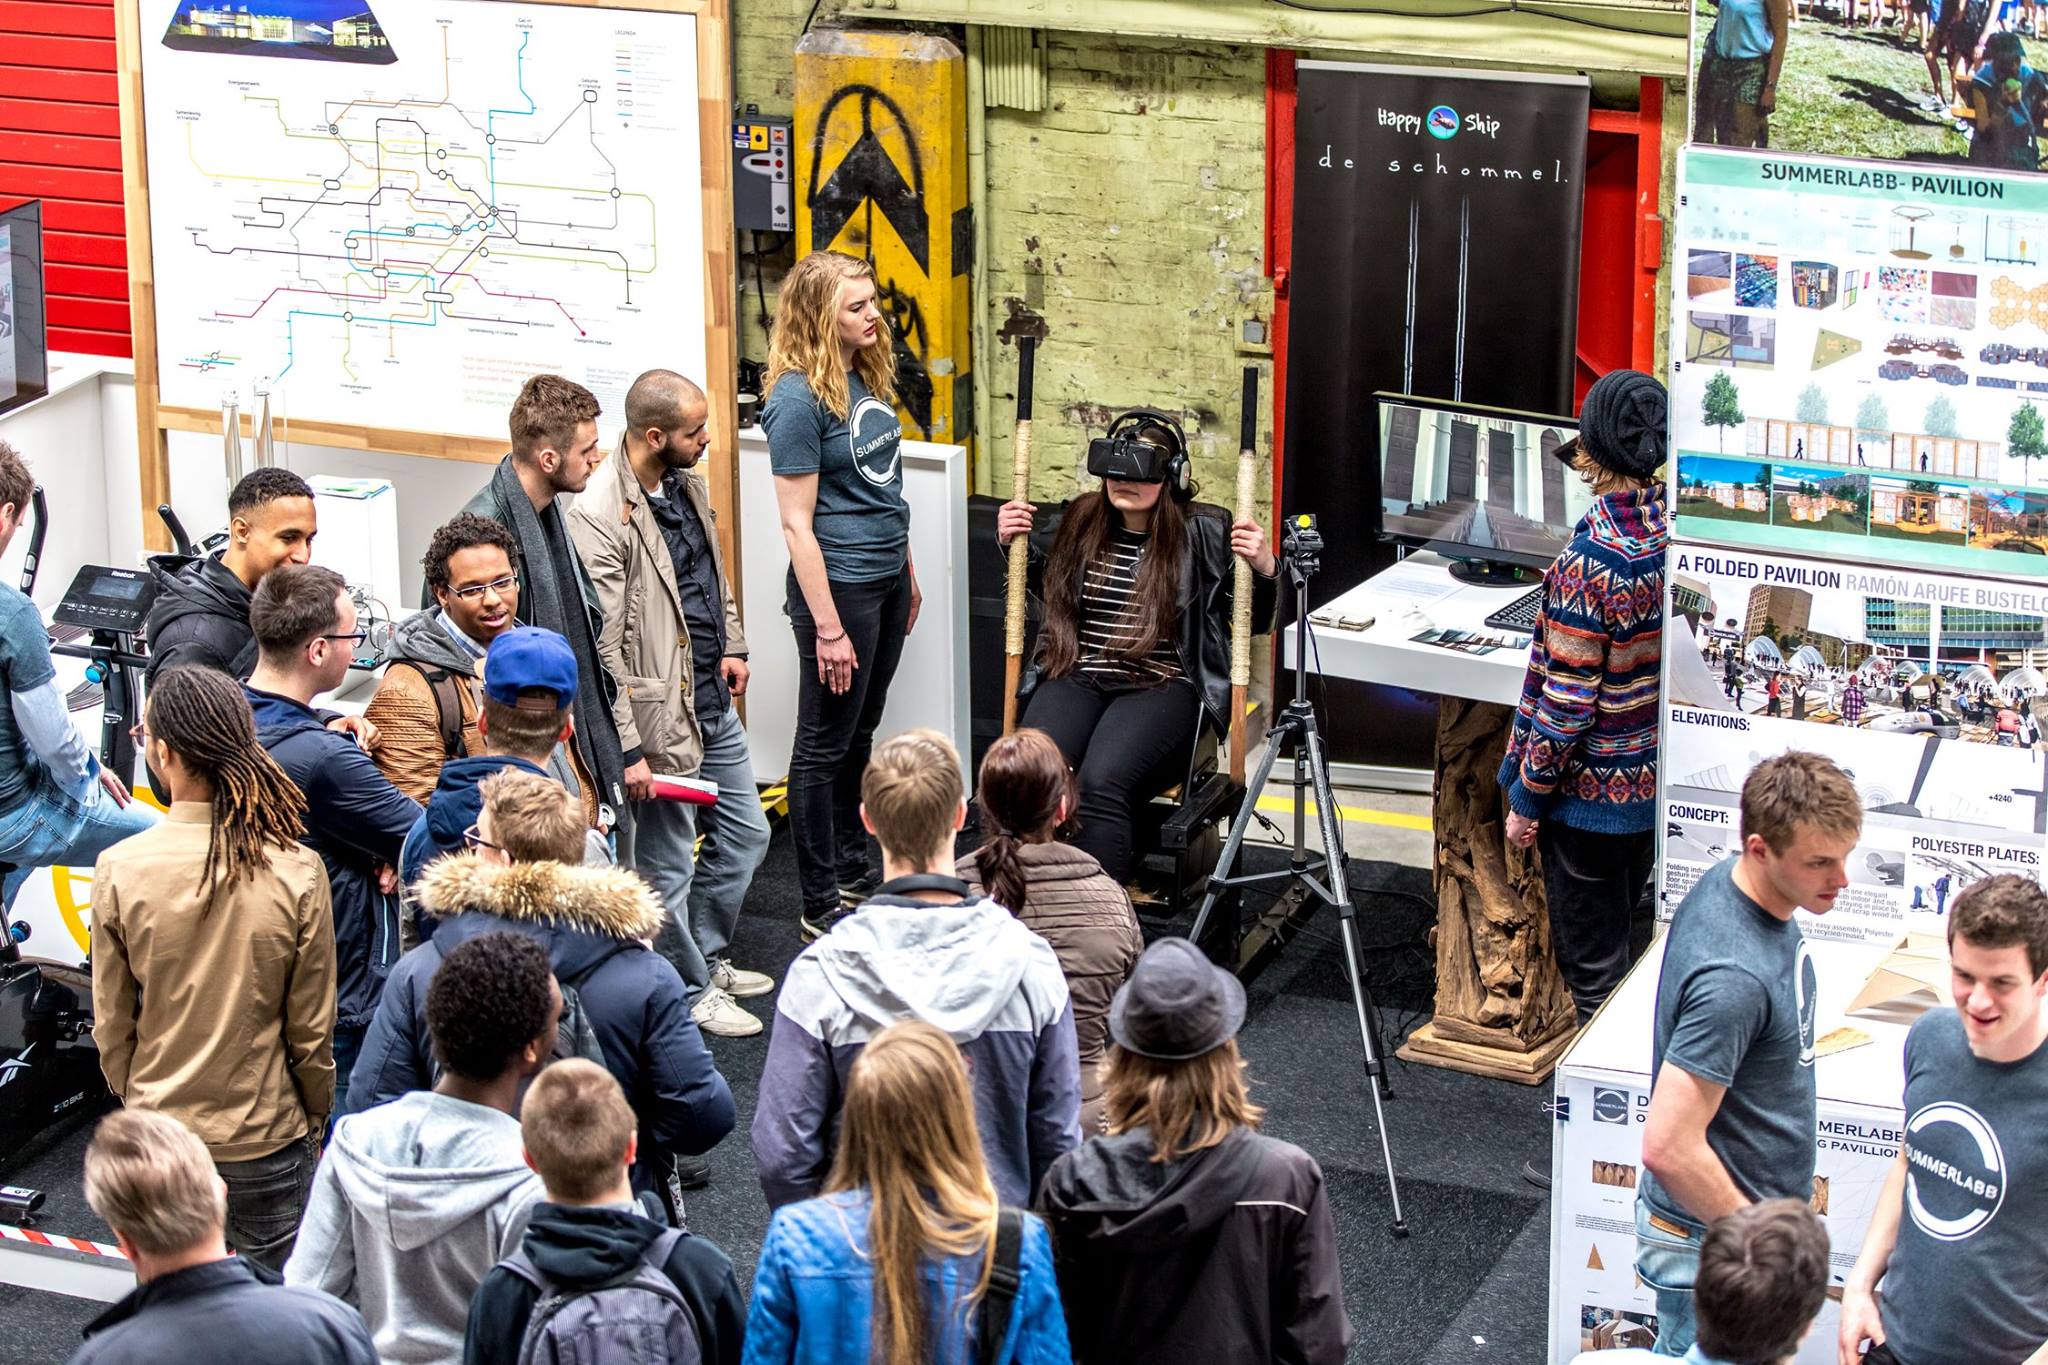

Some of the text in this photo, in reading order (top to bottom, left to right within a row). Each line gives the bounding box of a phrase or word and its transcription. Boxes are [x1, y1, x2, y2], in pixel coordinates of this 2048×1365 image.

[1377, 107, 1501, 138] Happy Ship
[1319, 144, 1355, 169] de
[1912, 177, 2004, 198] PAVILION
[856, 425, 902, 458] SUMMERLAB
[1678, 554, 1689, 572] A
[1695, 556, 1759, 579] FOLDED
[1764, 564, 1841, 589] PAVILION
[1846, 573, 1909, 598] RAMÓN
[1914, 583, 1970, 603] ARUFE
[1672, 709, 1750, 731] ELEVATIONS:
[1669, 804, 1729, 824] CONCEPT:
[1912, 836, 2039, 865] POLYESTER PLATES:
[1666, 863, 1689, 872] Folding
